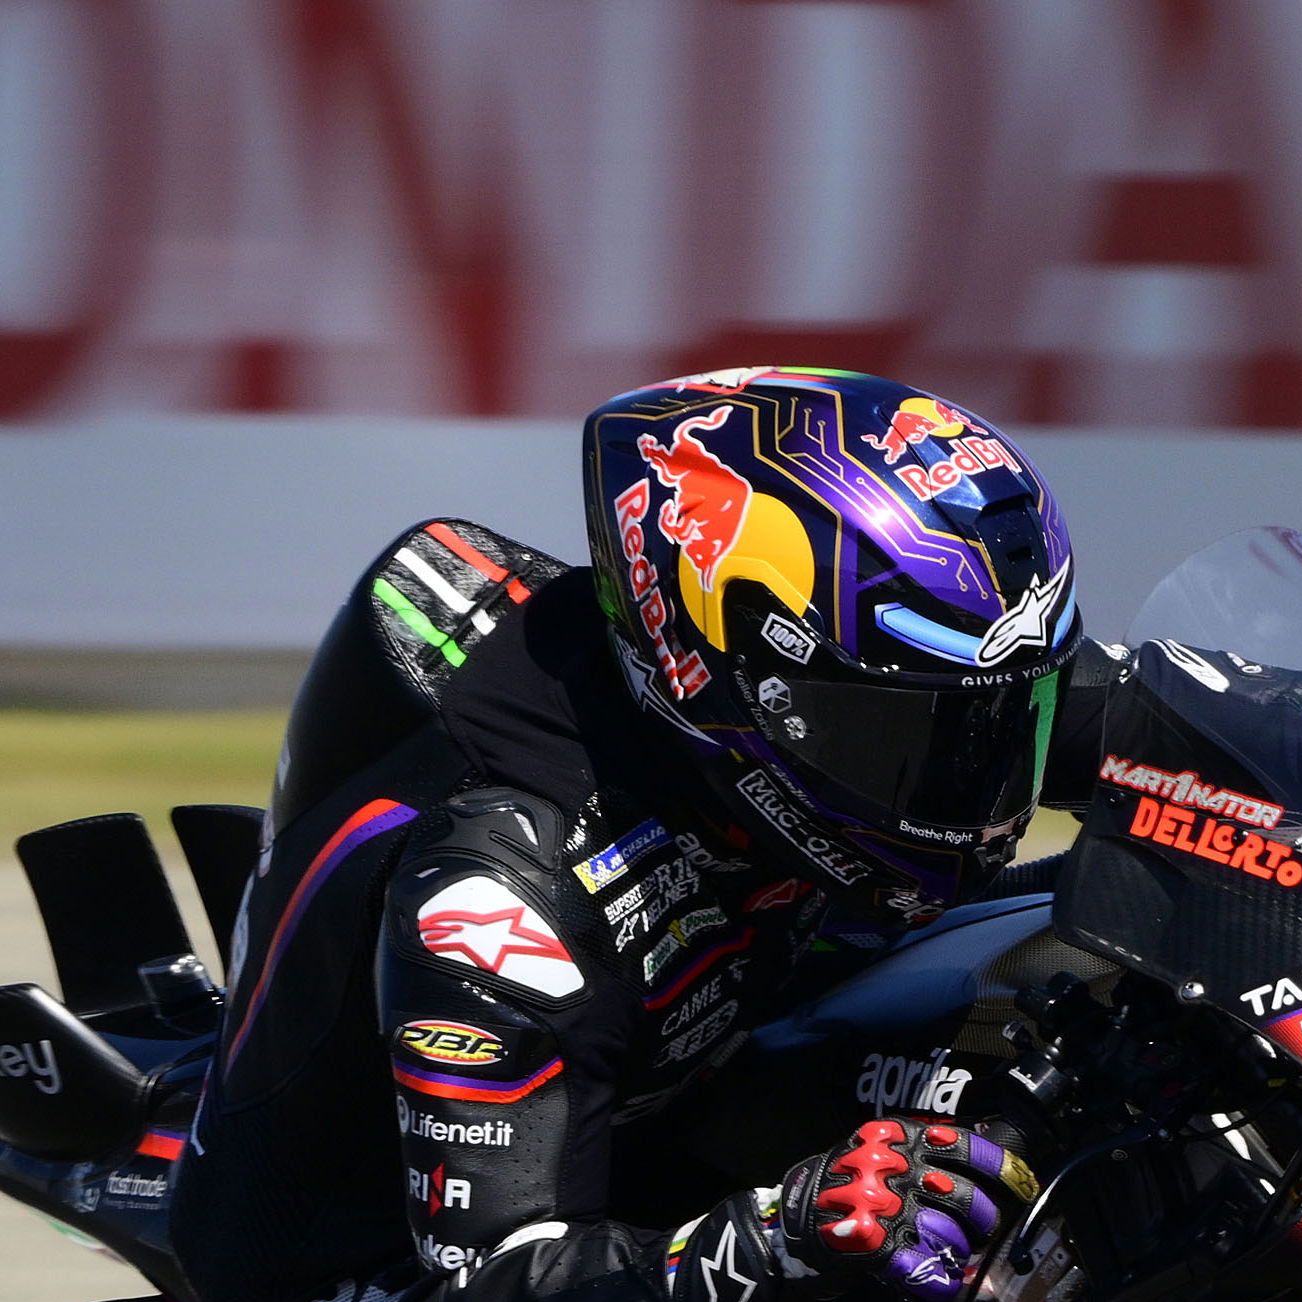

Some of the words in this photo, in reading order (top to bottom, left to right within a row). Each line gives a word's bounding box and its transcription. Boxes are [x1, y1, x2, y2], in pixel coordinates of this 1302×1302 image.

[769, 622, 808, 656] 100%
[961, 674, 1013, 687] GIVES
[1022, 663, 1049, 681] YOU
[899, 820, 945, 843] Breathe
[944, 830, 974, 845] Right
[410, 1110, 514, 1147] Lifenet.it
